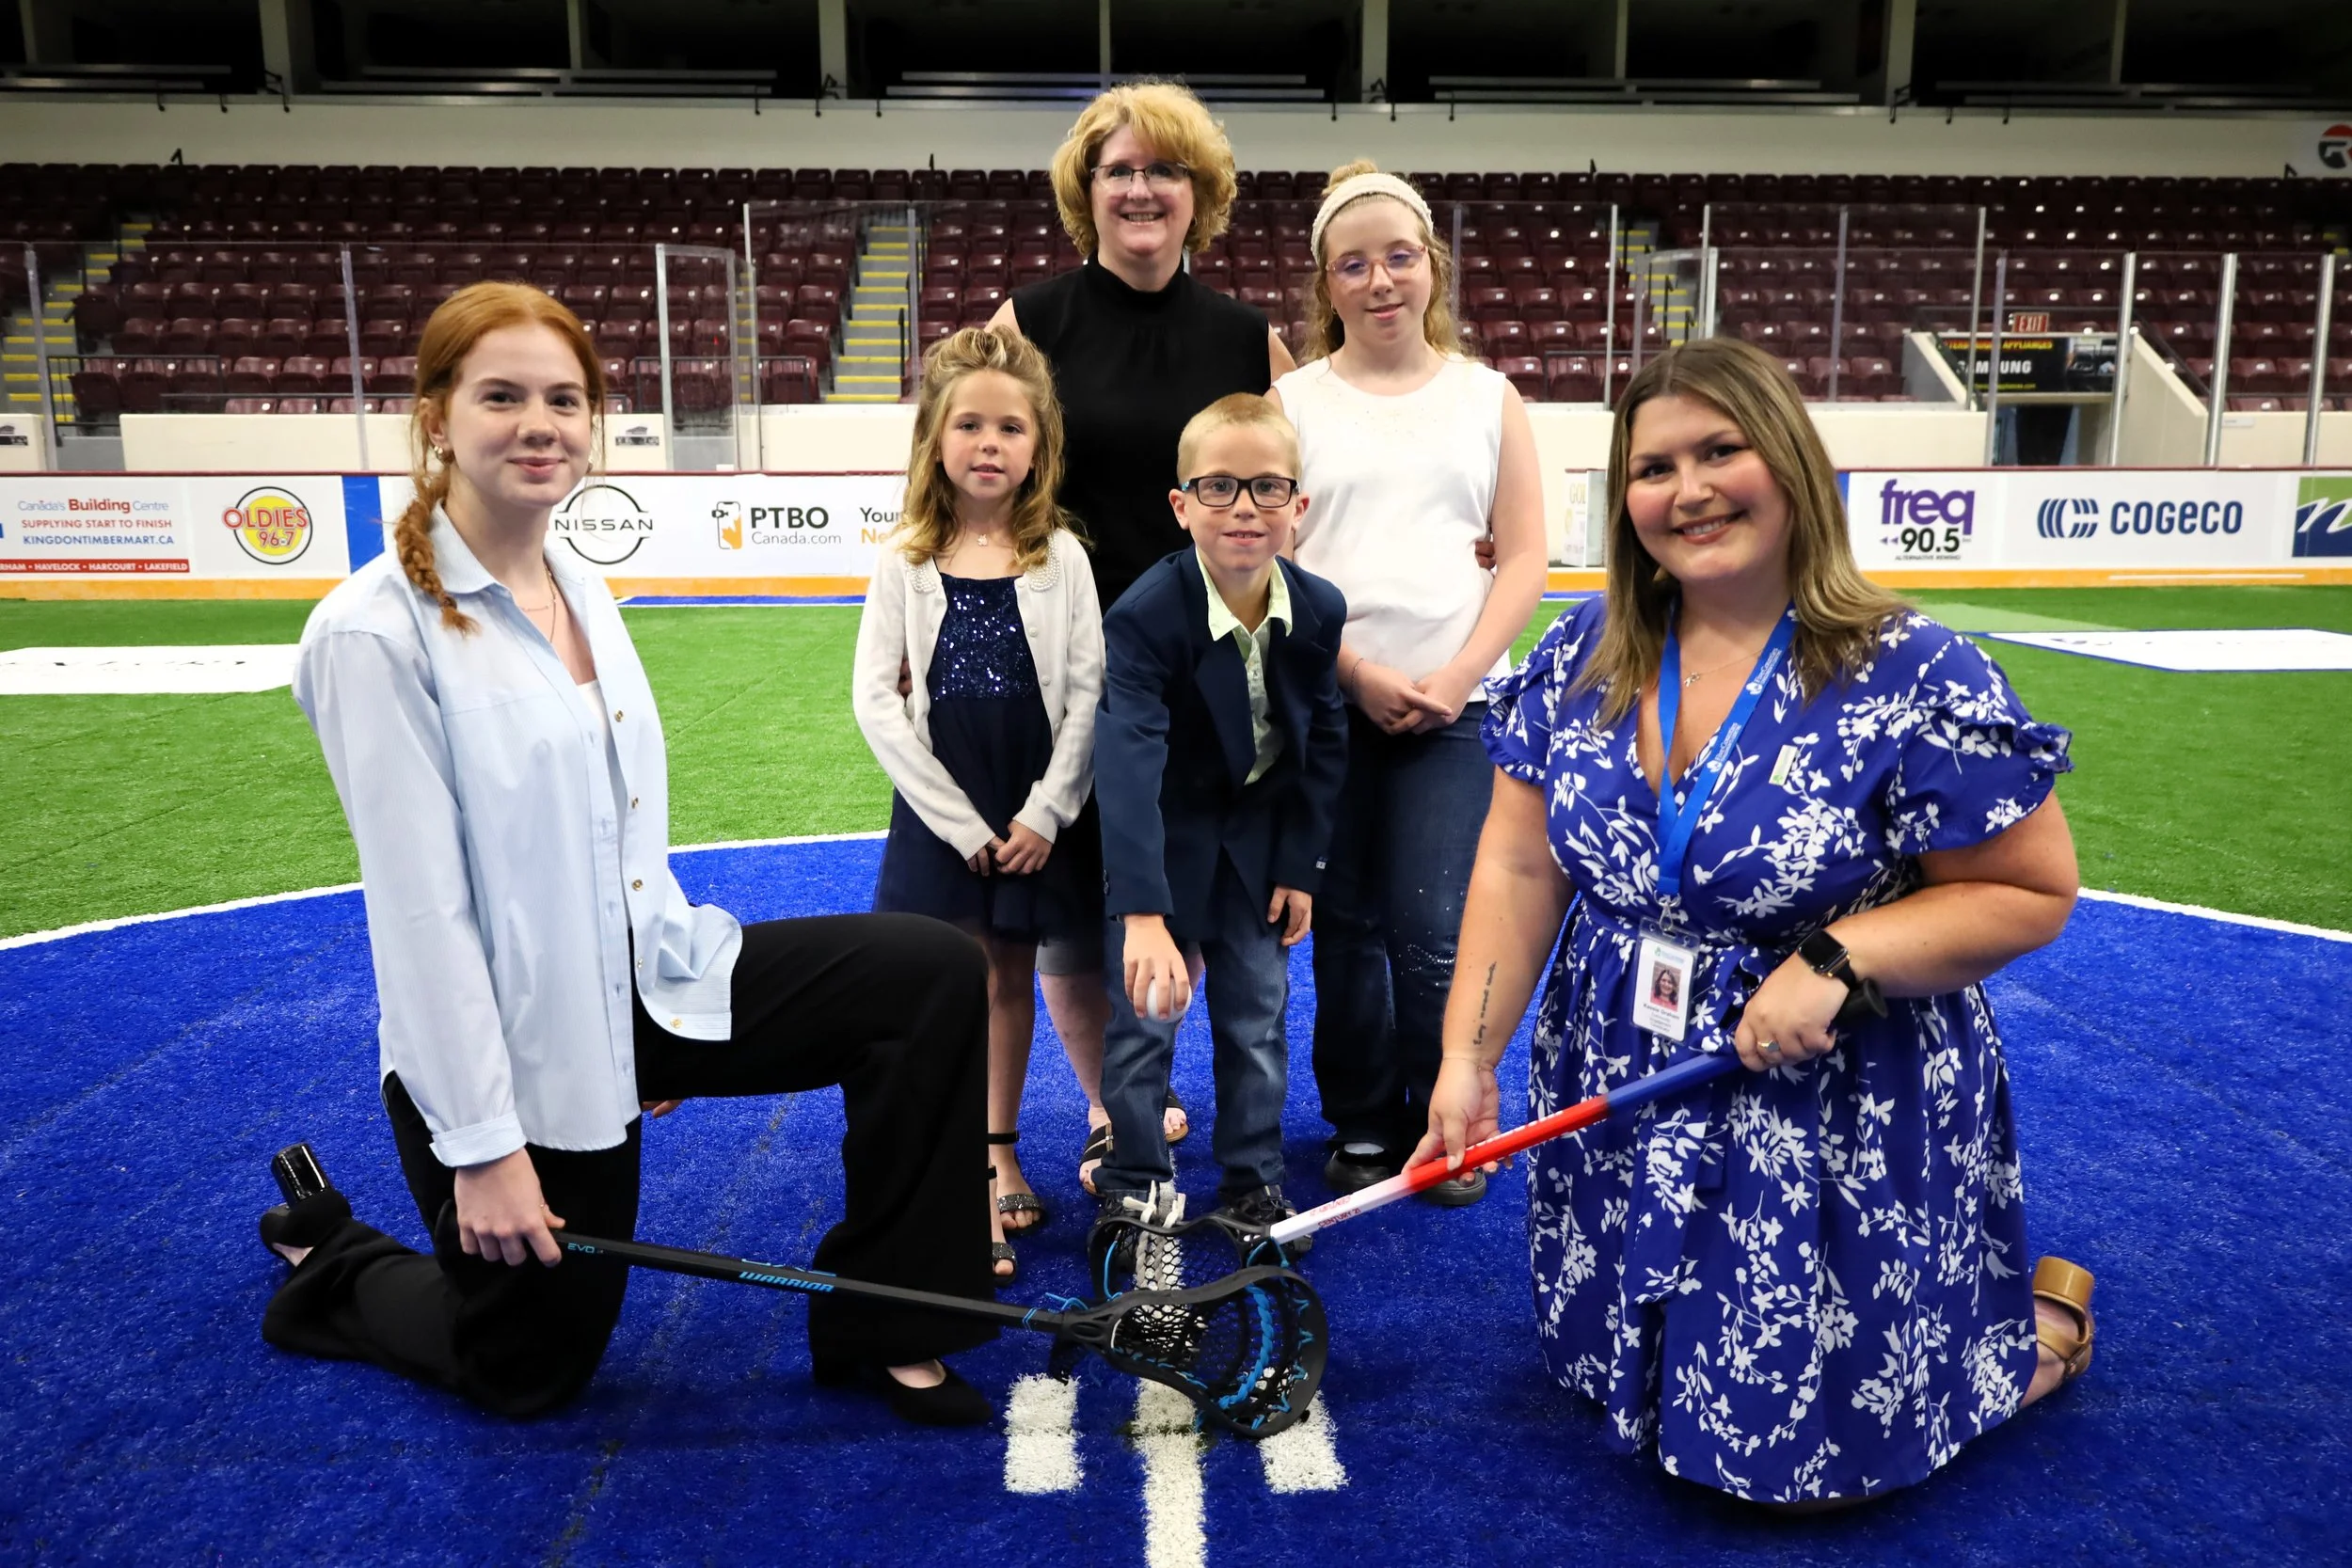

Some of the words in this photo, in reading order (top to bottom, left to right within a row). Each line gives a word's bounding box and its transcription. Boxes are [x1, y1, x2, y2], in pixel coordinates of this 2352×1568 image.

[2018, 315, 2043, 331] EXIT
[1956, 360, 2032, 373] SMUNG
[18, 500, 66, 511] Canada's
[68, 499, 131, 514] Building
[133, 501, 168, 511] Centre
[1880, 479, 1975, 535] freq
[22, 520, 82, 529] SUPPLYING
[223, 508, 309, 529] OLDIES
[554, 519, 653, 531] NISSAN
[750, 507, 829, 529] PTBO
[23, 536, 175, 545] KINGDONTIMBERMART.CA
[752, 531, 842, 545] Canada.com
[1900, 528, 1961, 553] 90.5
[1318, 1211, 1352, 1227] CENTURY
[567, 1243, 595, 1254] EVO
[739, 1271, 834, 1292] WARRIOR
